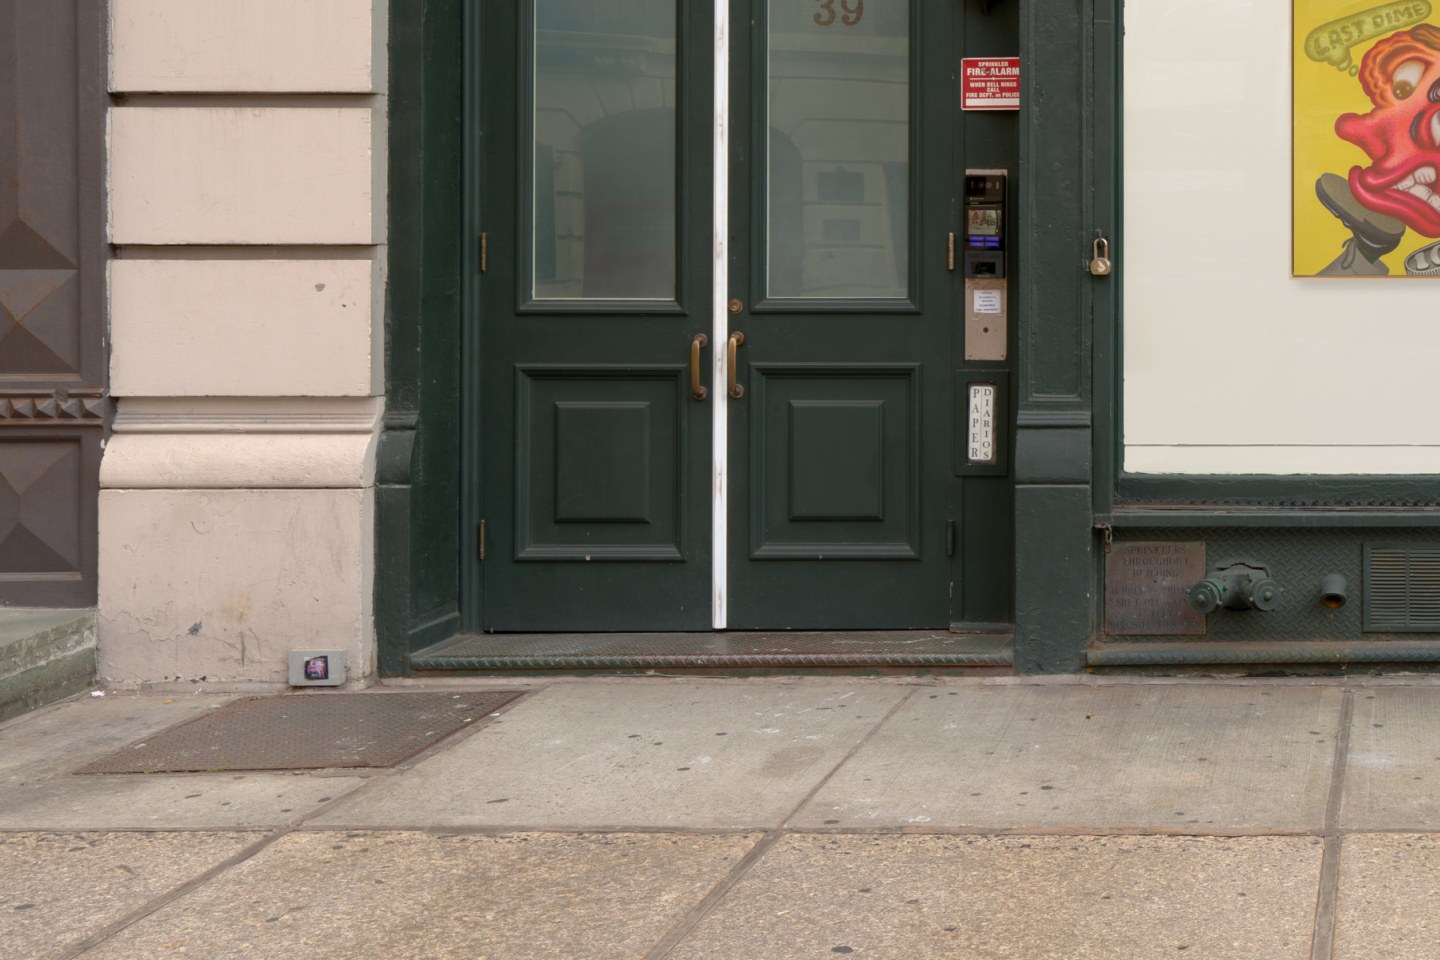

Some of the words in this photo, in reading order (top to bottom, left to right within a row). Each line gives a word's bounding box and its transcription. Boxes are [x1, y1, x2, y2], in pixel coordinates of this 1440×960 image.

[1313, 19, 1366, 57] LAST
[1371, 3, 1425, 29] DIME
[966, 67, 1020, 76] FIRE-ALARM
[971, 388, 980, 458] PAPER
[982, 388, 992, 459] DIARIOS
